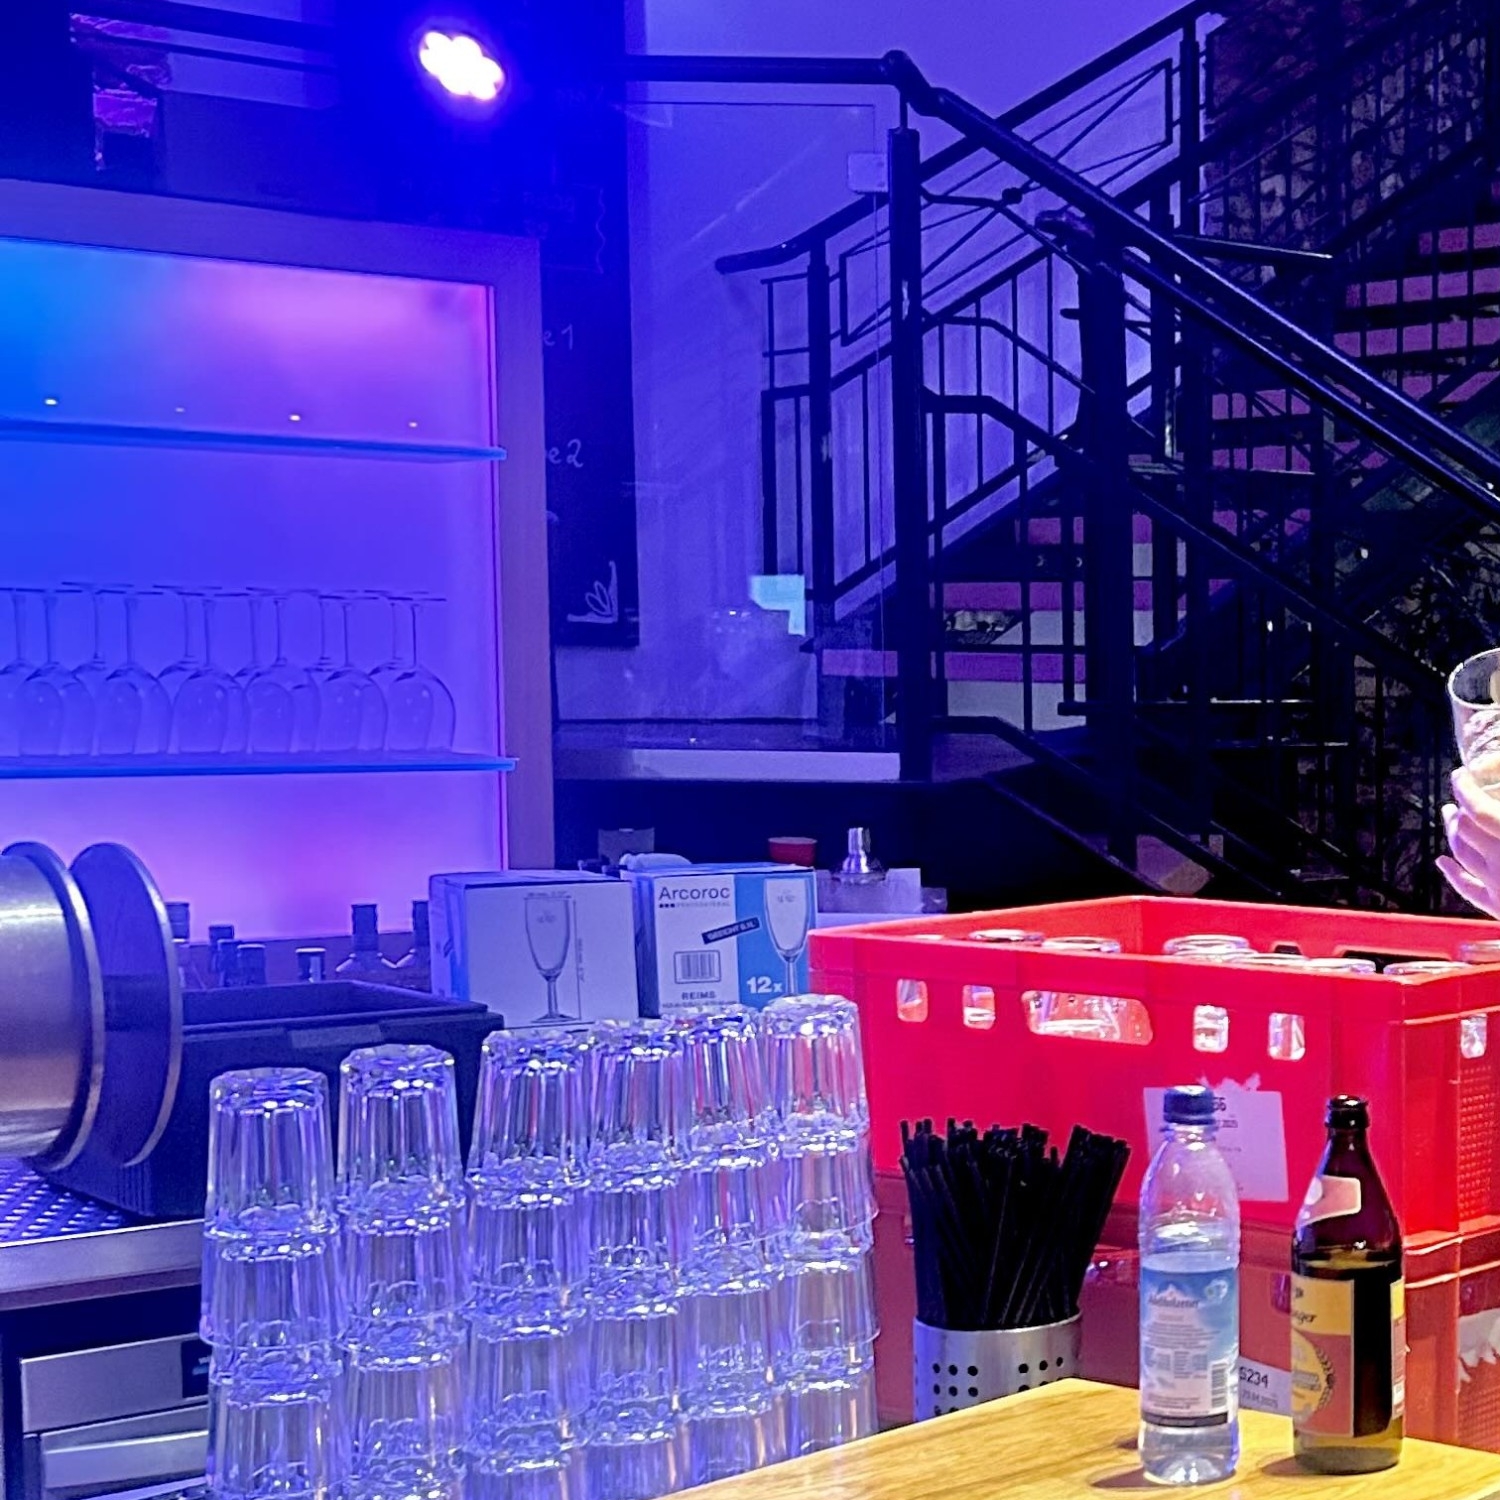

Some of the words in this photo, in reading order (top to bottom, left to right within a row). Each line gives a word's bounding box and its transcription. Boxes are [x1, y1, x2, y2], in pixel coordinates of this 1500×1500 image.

[658, 887, 730, 900] Arcoroc
[747, 976, 783, 994] 12x
[681, 991, 716, 1000] REIMS
